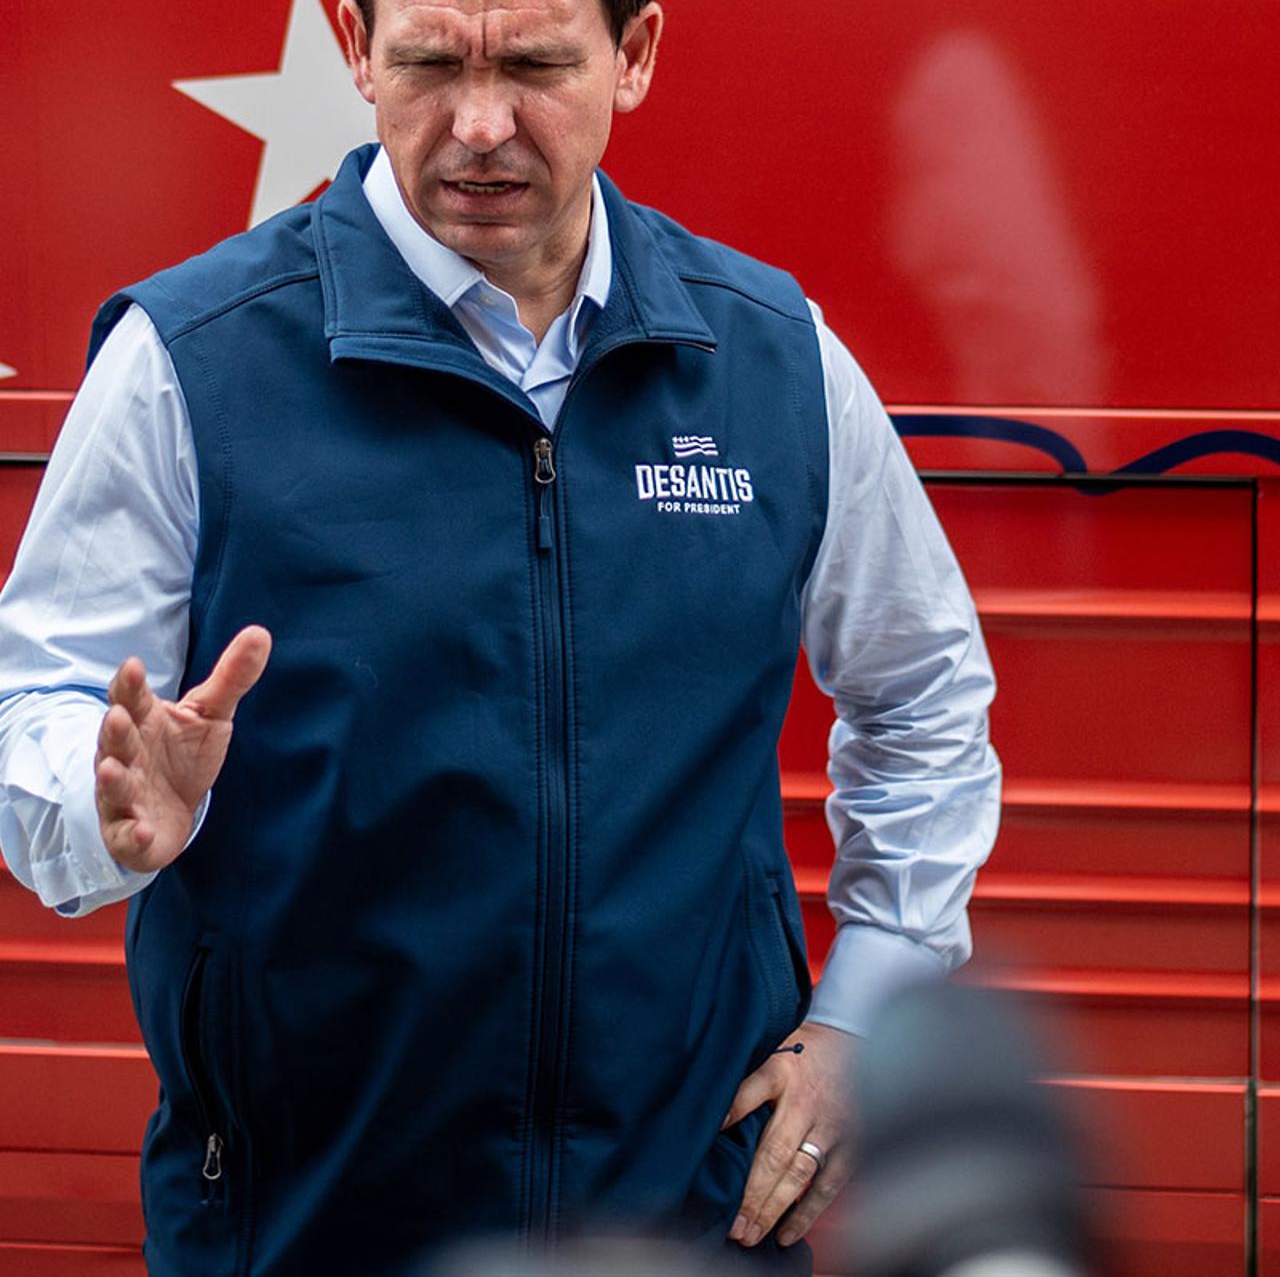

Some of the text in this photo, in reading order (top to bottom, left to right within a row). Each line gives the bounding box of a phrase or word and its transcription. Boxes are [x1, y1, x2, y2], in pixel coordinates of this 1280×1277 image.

[635, 465, 754, 502] DESANTIS
[657, 501, 740, 515] FOR PRESIDENT
